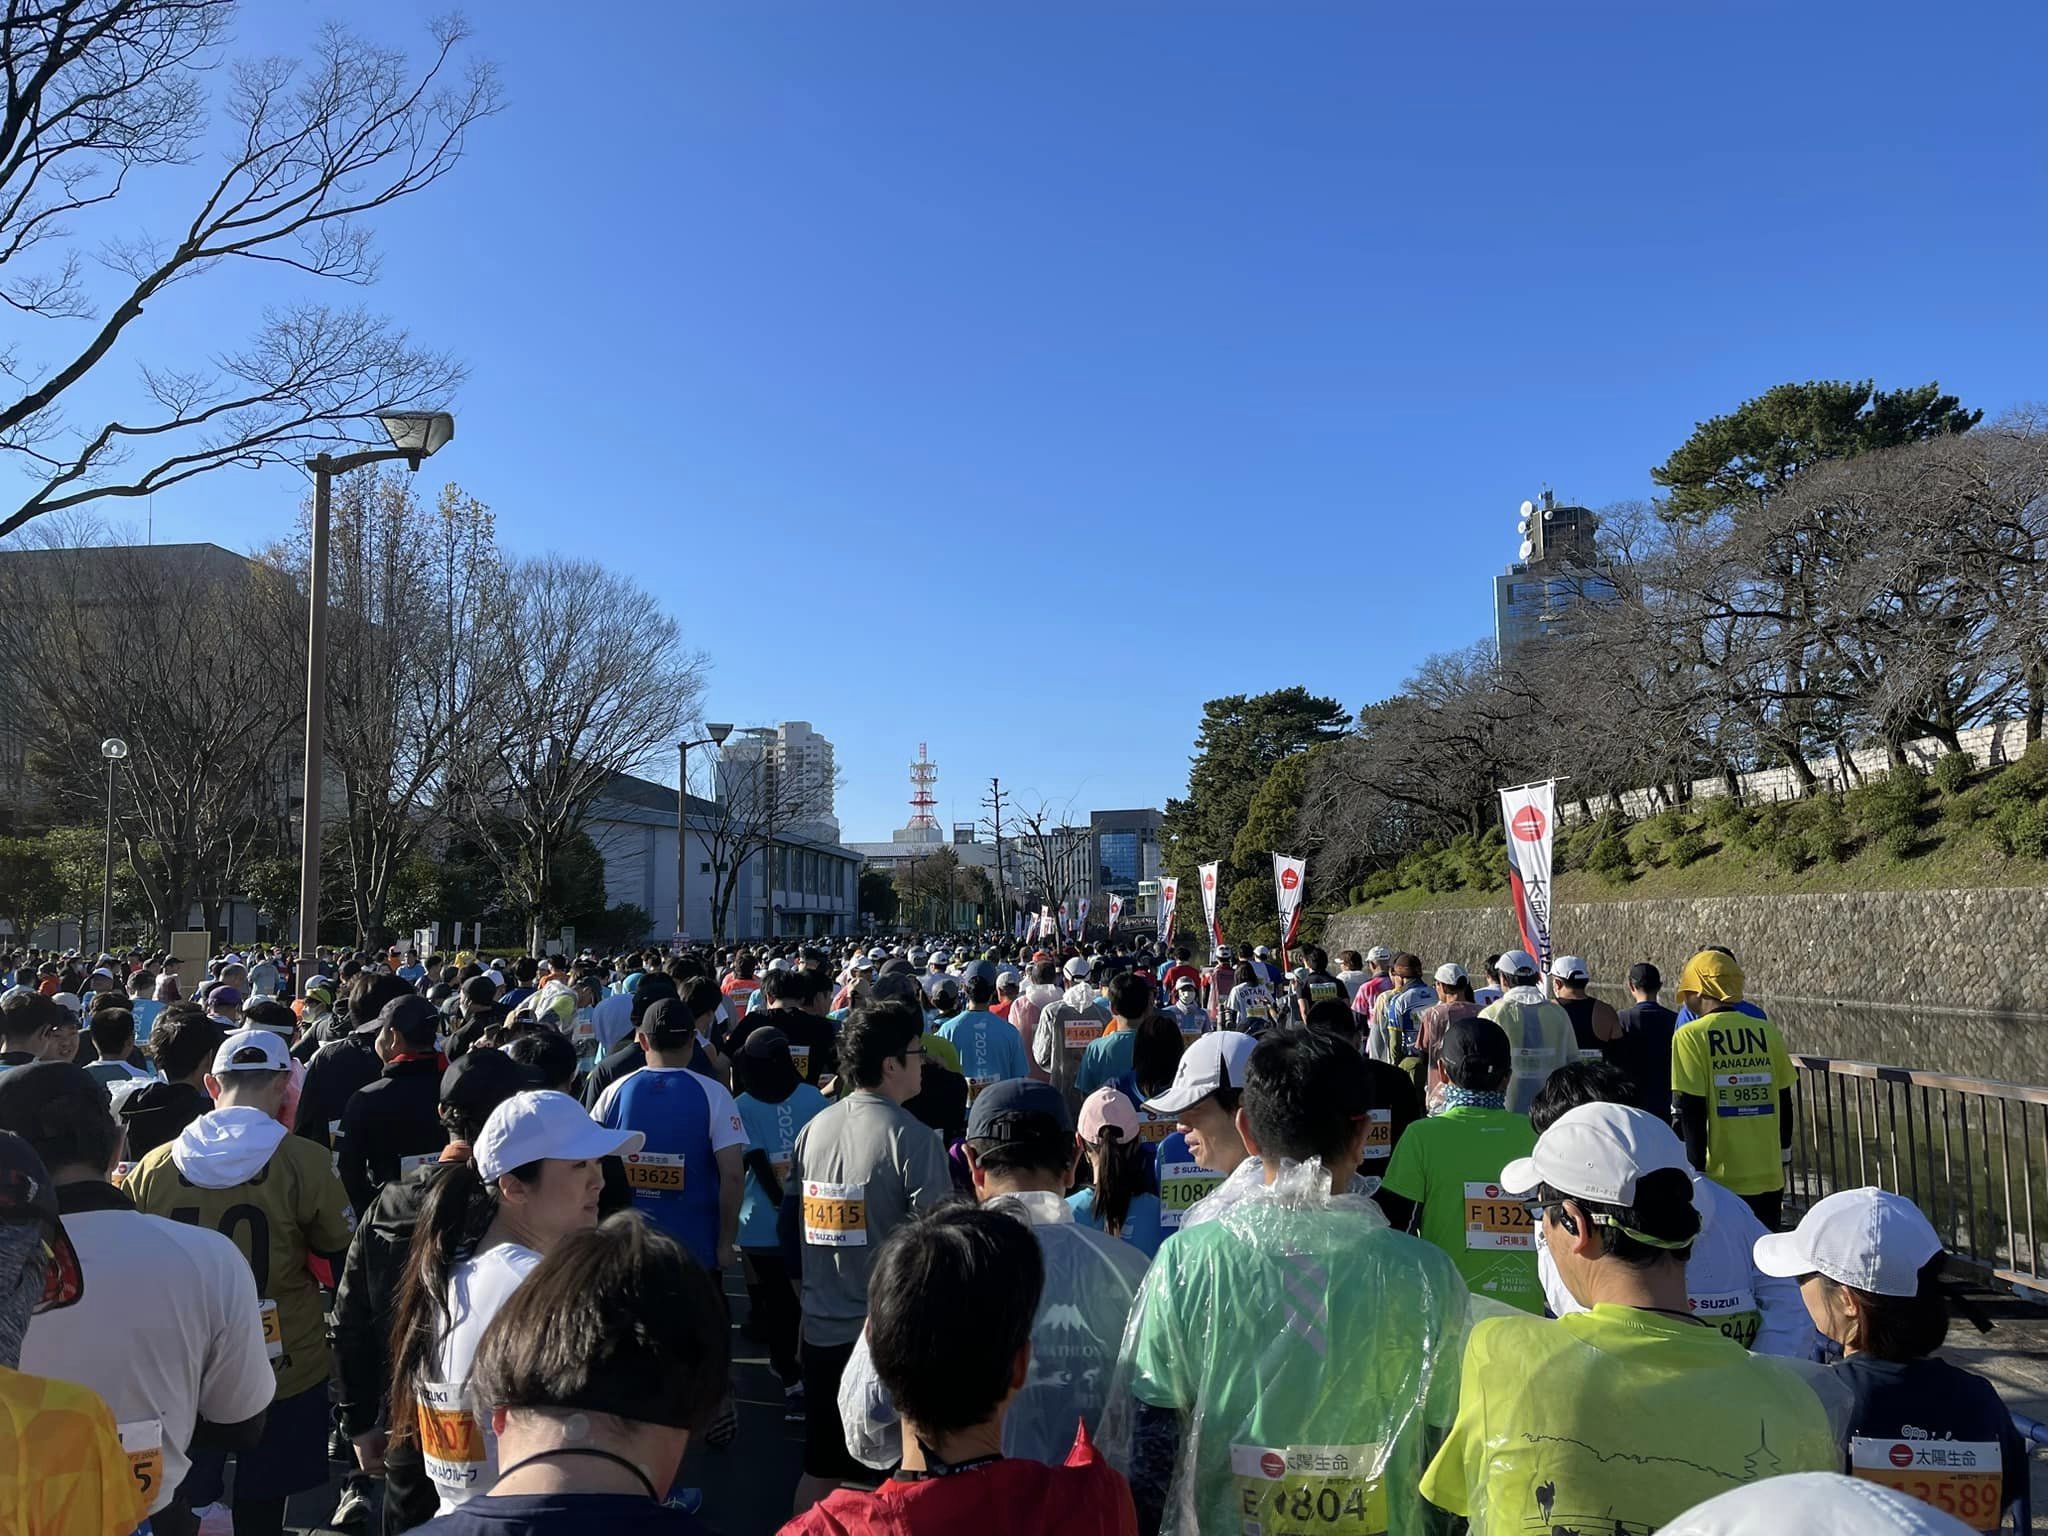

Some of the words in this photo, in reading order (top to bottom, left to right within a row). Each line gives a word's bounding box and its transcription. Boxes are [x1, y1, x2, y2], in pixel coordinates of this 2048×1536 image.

[975, 1032, 987, 1066] 2024
[1707, 1027, 1768, 1057] RUN
[1713, 1057, 1771, 1070] KANAZAWA
[1719, 1089, 1728, 1100] E
[1734, 1087, 1769, 1101] 9853
[776, 1103, 794, 1150] 2024
[1367, 1126, 1389, 1141] 48
[629, 1168, 680, 1185] 13625
[1162, 1185, 1169, 1200] E
[809, 1203, 860, 1224] 14115
[1471, 1205, 1482, 1220] F
[815, 1233, 847, 1241] SUZUKI
[1916, 1448, 1977, 1467] 太陽生命
[133, 1461, 153, 1493] 5
